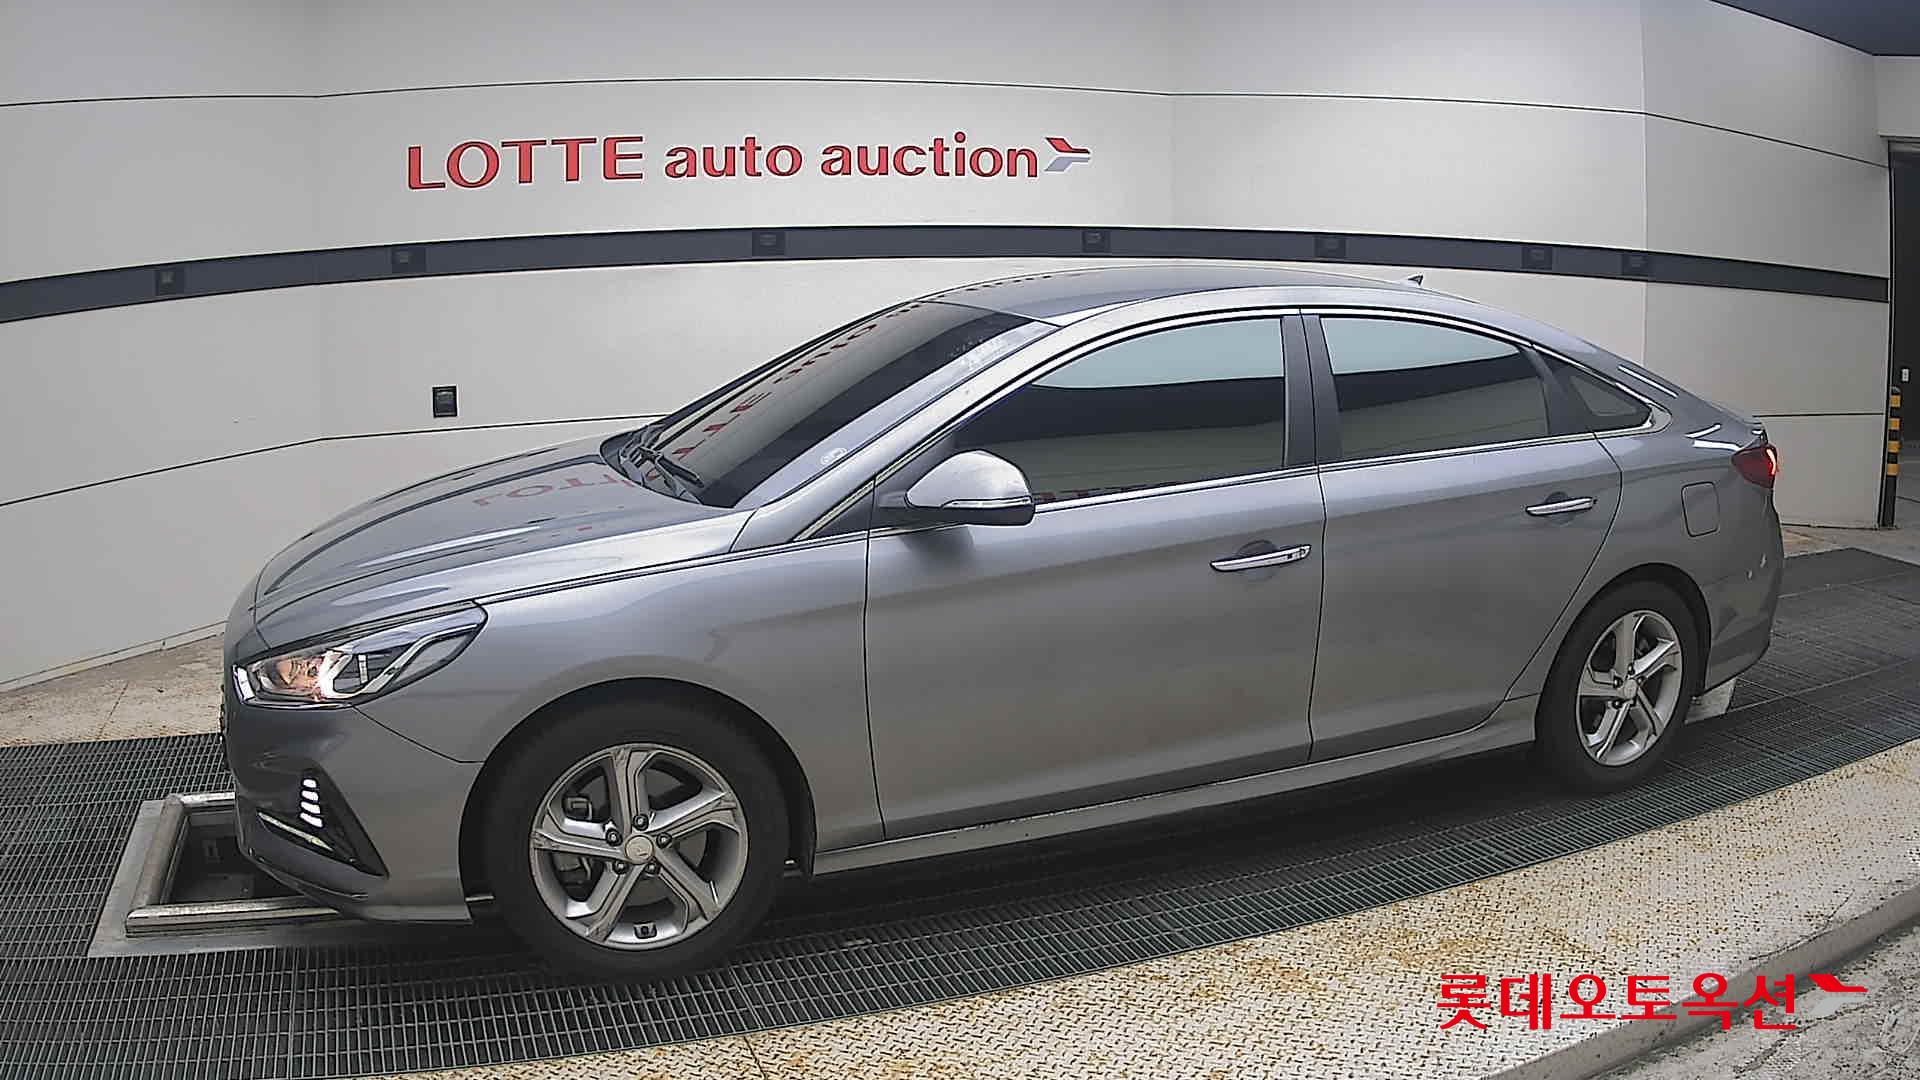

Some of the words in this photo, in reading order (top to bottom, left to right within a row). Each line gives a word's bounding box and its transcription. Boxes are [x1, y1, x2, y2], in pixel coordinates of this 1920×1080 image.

[407, 135, 644, 190] LOTTE
[664, 136, 803, 178] auto
[820, 131, 1039, 178] auction
